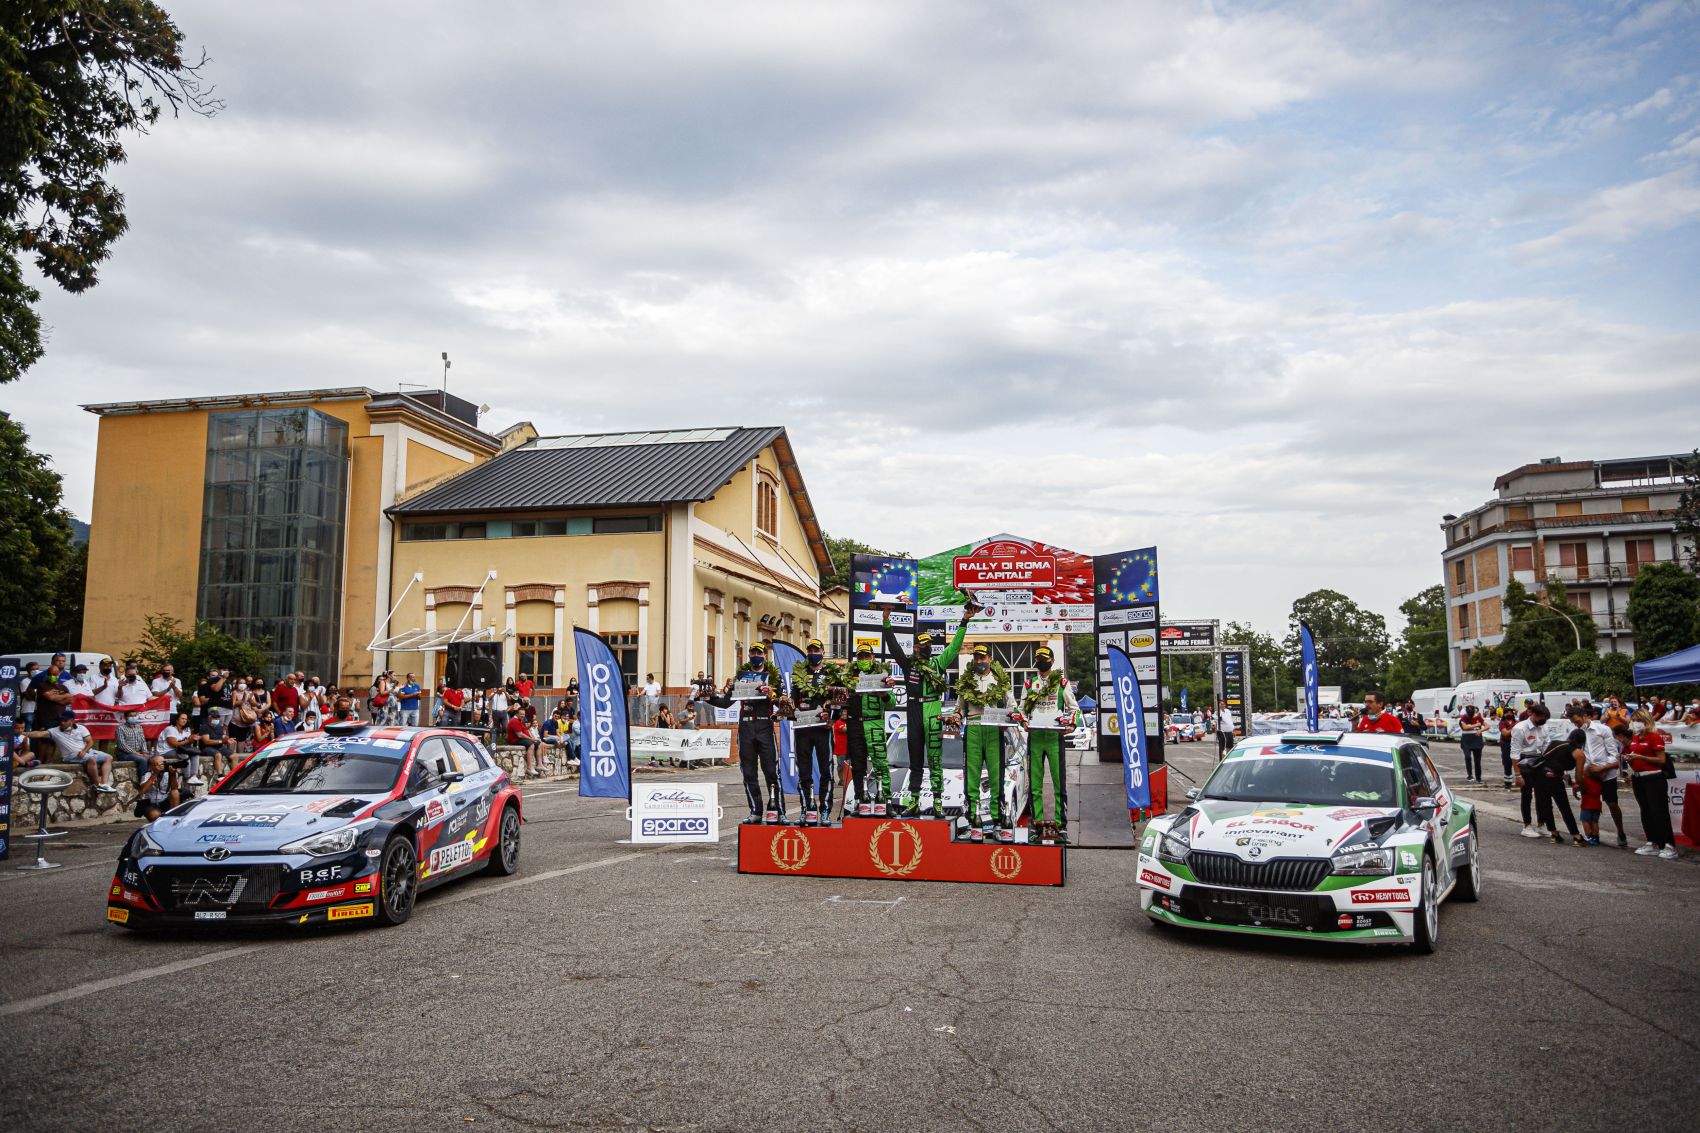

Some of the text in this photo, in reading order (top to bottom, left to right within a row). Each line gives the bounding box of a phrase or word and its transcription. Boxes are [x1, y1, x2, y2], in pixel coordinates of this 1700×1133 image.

[959, 561, 1052, 571] RALLY DI ROMA
[977, 571, 1033, 580] CAPITALE
[1005, 593, 1032, 601] sparco
[1127, 609, 1153, 620] sparco
[1100, 637, 1123, 646] SONY
[1190, 638, 1211, 646] FERMÉ
[648, 791, 690, 803] Rally
[206, 813, 282, 824] Adeos
[643, 819, 708, 836] sparco
[1251, 817, 1315, 832] SABOR
[196, 834, 217, 842] ACI
[440, 841, 471, 865] PELETTO
[781, 838, 801, 862] II
[888, 831, 904, 867] I
[997, 855, 1015, 870] III
[355, 883, 371, 892] OMP
[1375, 892, 1409, 900] HEAVY TOOLS
[331, 905, 370, 918] PIRELLI
